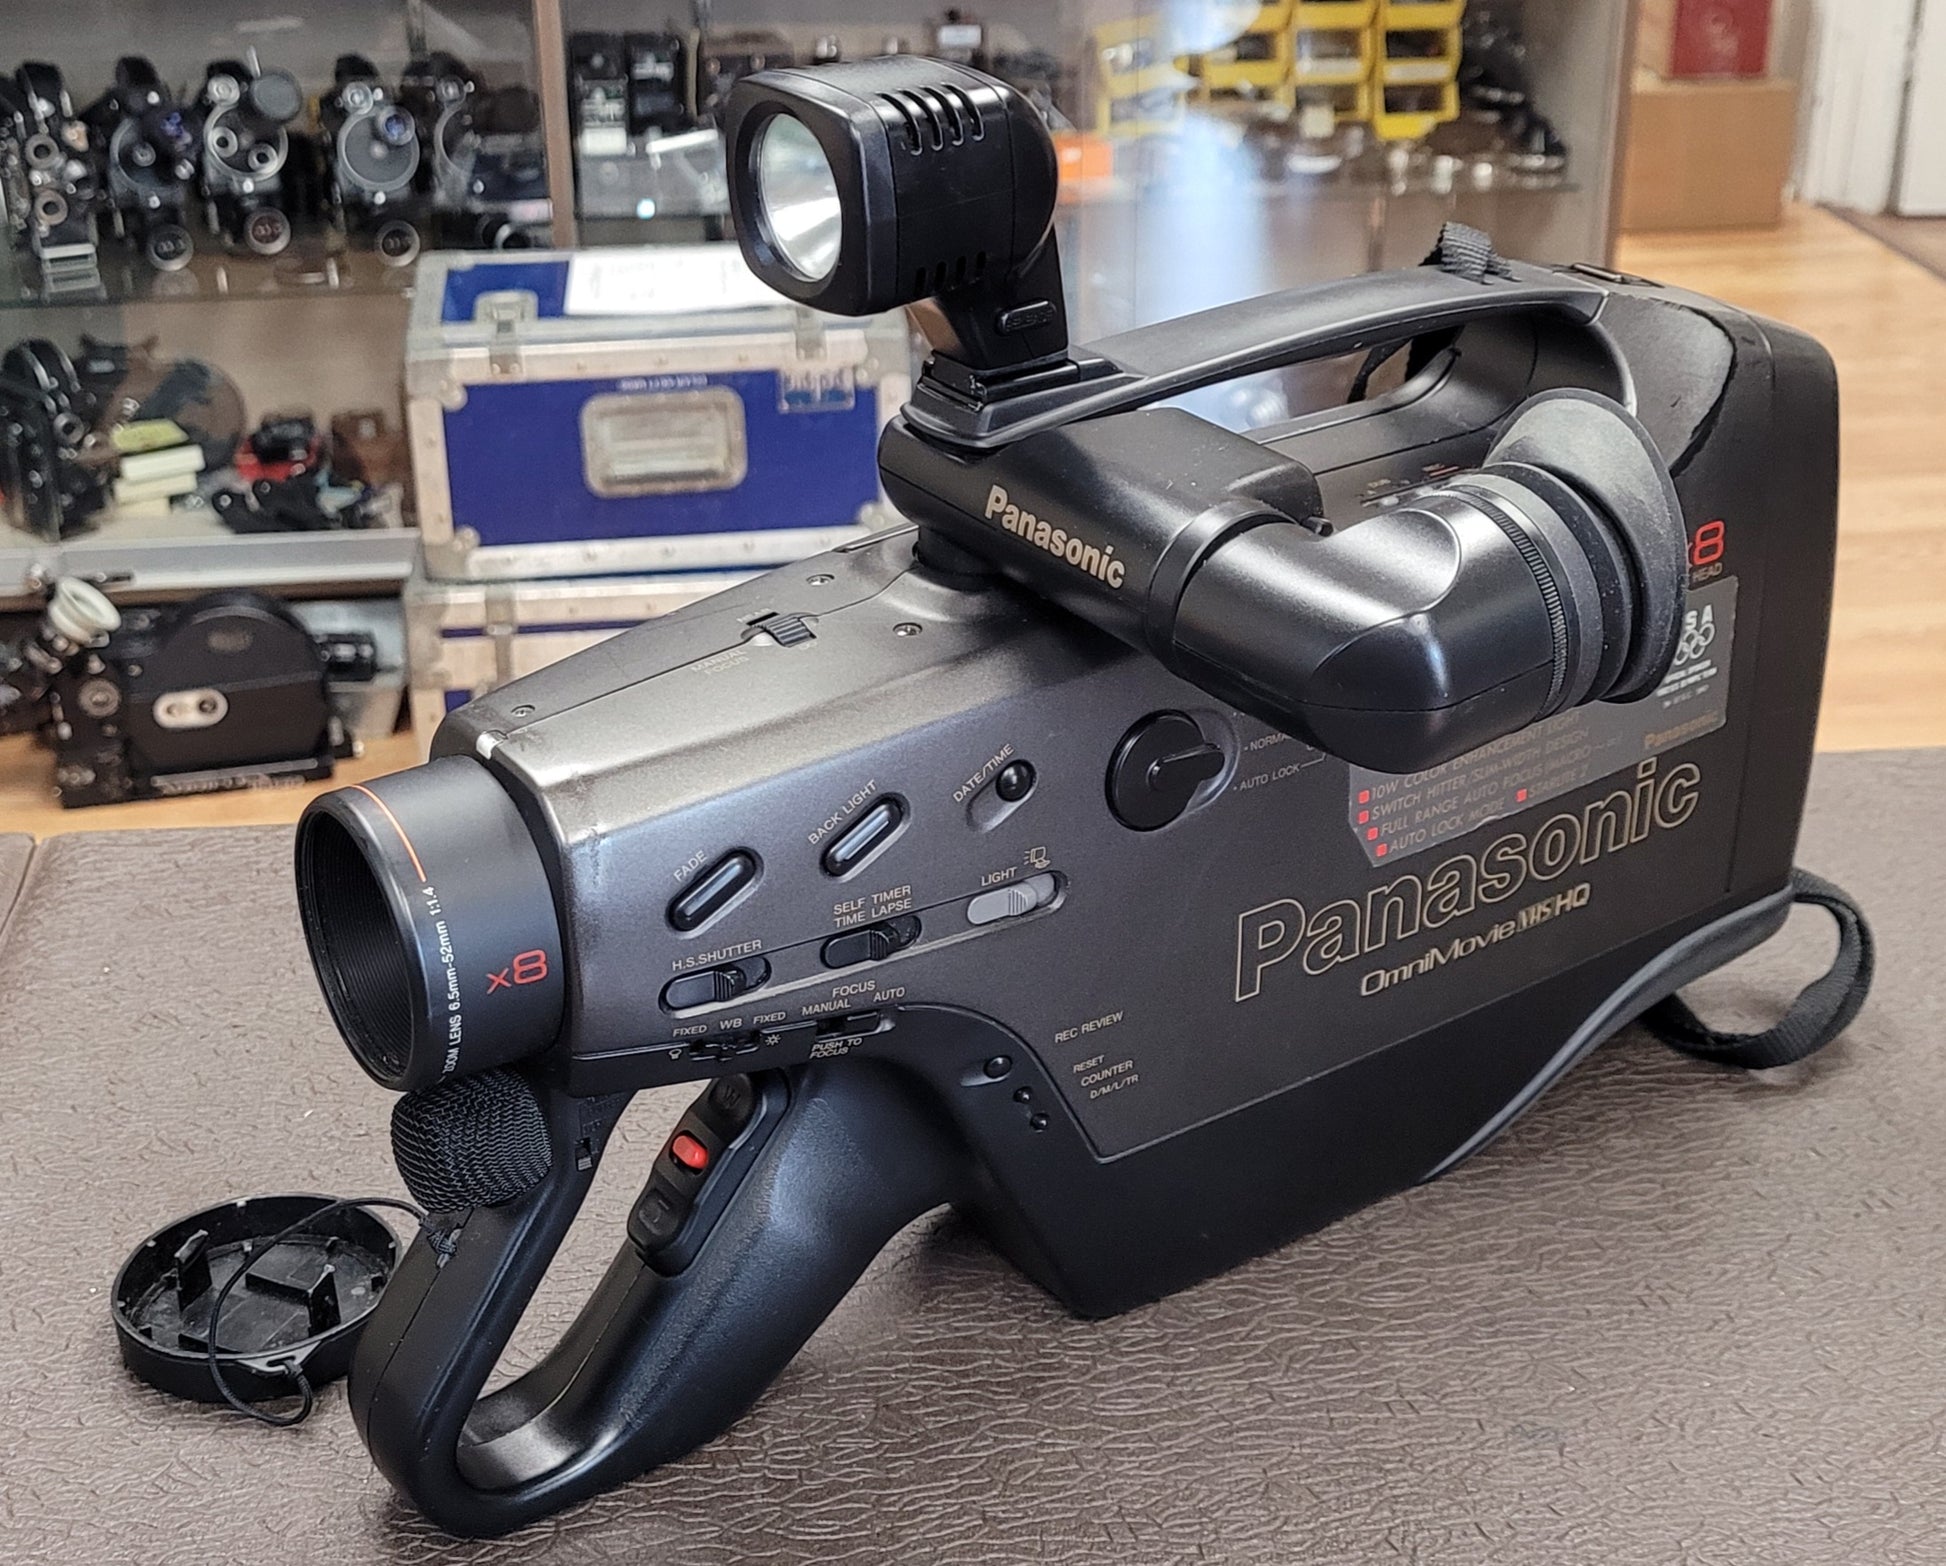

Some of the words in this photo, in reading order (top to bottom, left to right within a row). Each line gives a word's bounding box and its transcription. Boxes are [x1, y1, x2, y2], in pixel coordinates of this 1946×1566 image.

[985, 484, 1125, 588] Panasonic
[1687, 520, 1725, 568] 8
[1685, 604, 1714, 630] SA
[952, 743, 1015, 803] DATE/TIME
[1240, 774, 1269, 791] AUTO
[1272, 763, 1300, 781] LOCK
[1372, 781, 1398, 800] 10W
[1404, 766, 1449, 788] COLOR
[808, 813, 842, 846] BACK
[841, 779, 878, 818] LIGHT
[1372, 788, 1422, 822] SWITCH
[1381, 816, 1409, 836] FULL
[1415, 796, 1458, 825] RANGE
[1464, 780, 1499, 805] AUTO
[1503, 763, 1545, 788] FOCUS
[1389, 828, 1427, 853] AUTO
[1431, 812, 1464, 838] LOCK
[1468, 797, 1507, 823] MODE
[673, 850, 708, 883] FADE
[981, 866, 1017, 887] LIGHT
[1235, 757, 1702, 1003] Panasonic
[422, 886, 442, 916] 1:1.4
[833, 897, 866, 915] SELF
[872, 884, 912, 905] TIMER
[833, 909, 867, 928] TIME
[871, 899, 912, 919] LAPSE
[436, 920, 460, 1011] 6.5mm-52mm
[672, 939, 762, 971] H.S.SHUTTER
[1361, 920, 1516, 998] OmniMovie
[801, 998, 851, 1016] MANUAL
[873, 987, 905, 1002] AUTO
[832, 979, 876, 998] FOCUS
[449, 1015, 462, 1046] LENS
[673, 1024, 708, 1037] FIXED
[719, 1018, 743, 1031] WB
[753, 1011, 786, 1025] FIXED
[1055, 1027, 1079, 1043] REC
[1081, 1010, 1124, 1034] REVIEW
[809, 1045, 849, 1060] FOCUS
[811, 1040, 844, 1052] PUSH
[848, 1037, 863, 1047] TO
[1073, 1054, 1105, 1073] RESET
[1081, 1060, 1133, 1087] COUNTER
